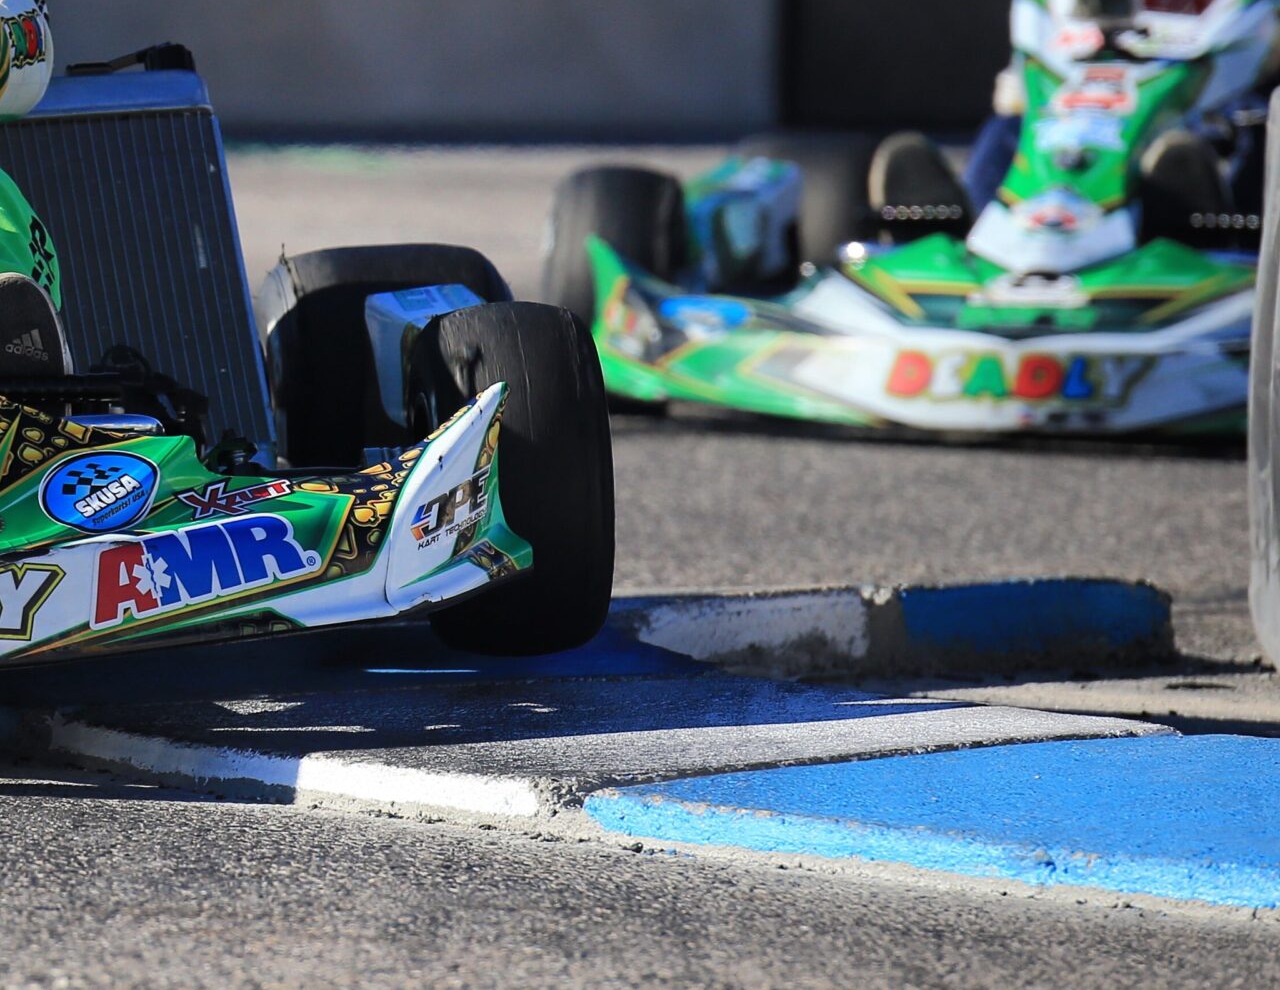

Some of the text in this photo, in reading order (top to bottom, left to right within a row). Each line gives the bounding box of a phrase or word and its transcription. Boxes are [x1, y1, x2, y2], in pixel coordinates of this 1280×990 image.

[5, 343, 49, 361] adidas
[73, 473, 142, 518] SKUSA
[132, 490, 146, 503] USA
[417, 533, 441, 551] KART
